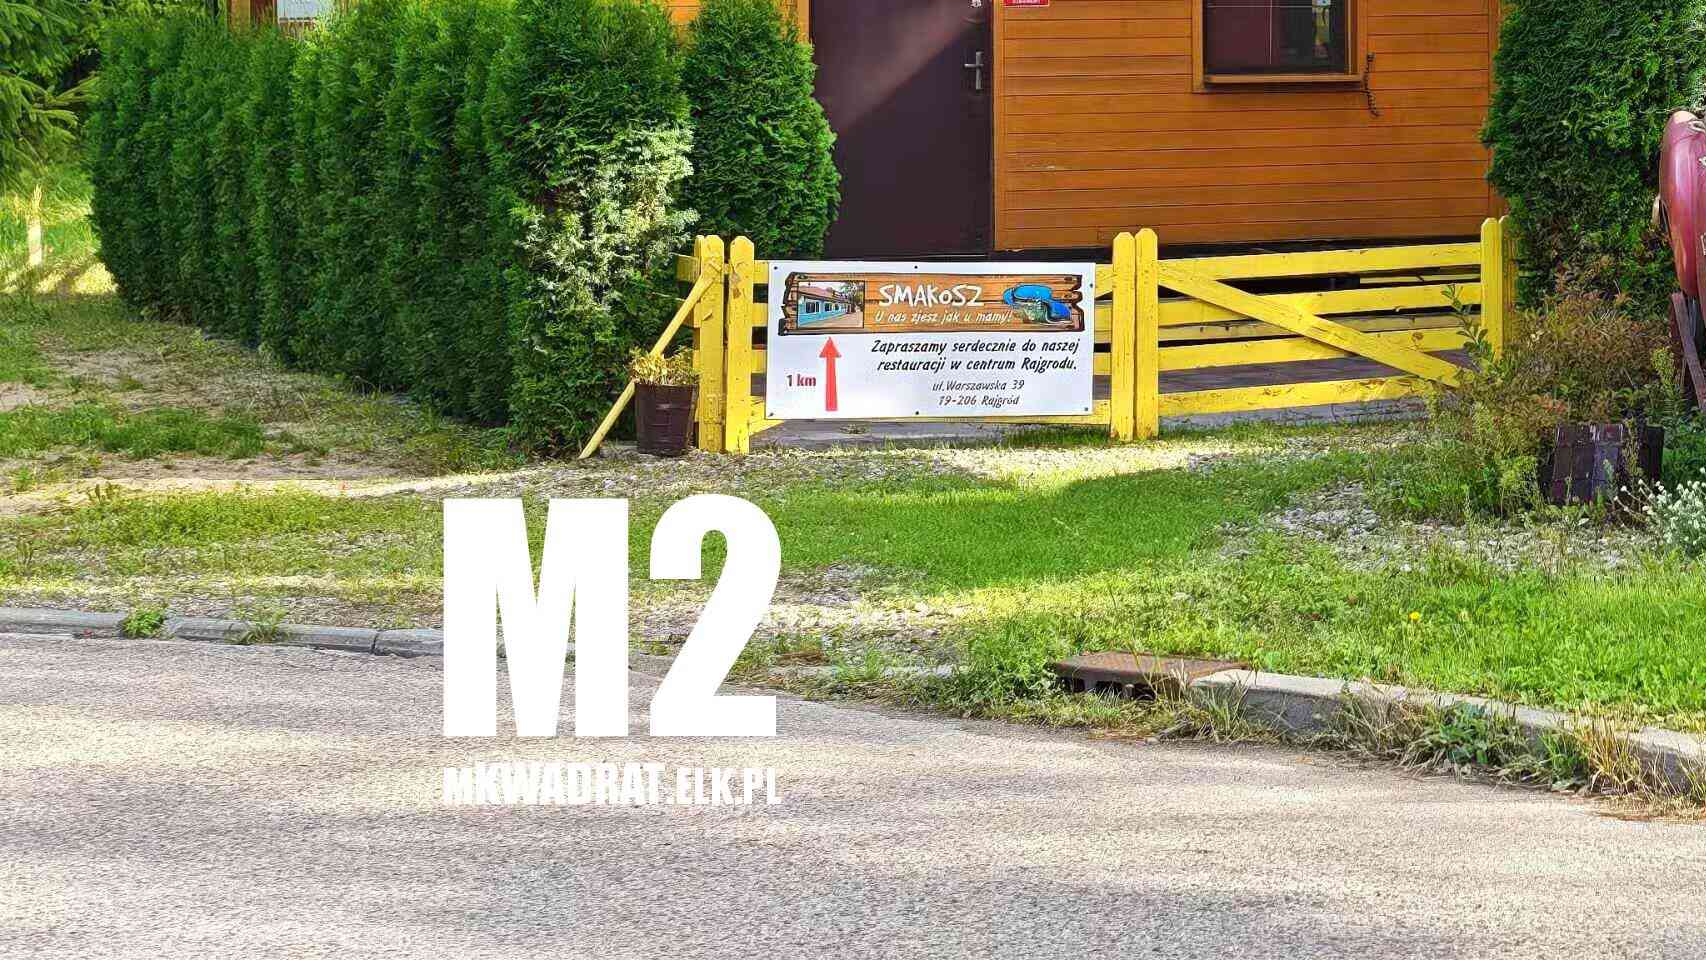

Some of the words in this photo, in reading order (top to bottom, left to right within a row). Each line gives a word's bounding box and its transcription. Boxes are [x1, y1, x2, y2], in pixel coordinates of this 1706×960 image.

[875, 311, 885, 322] U
[888, 313, 906, 321] nas
[911, 311, 939, 324] zjesz
[940, 310, 960, 324] jak
[963, 312, 972, 321] u
[976, 310, 1013, 324] mamy!
[871, 339, 948, 355] Zapraszamy
[952, 339, 1017, 353] serdecznie
[1021, 338, 1037, 352] do
[1041, 338, 1081, 355] naszej
[877, 356, 947, 374] restauracji
[950, 360, 960, 371] w
[966, 358, 1016, 371] centrum
[1021, 356, 1077, 374] Rajgrodu.
[786, 374, 793, 387] 1
[796, 373, 817, 387] km
[1011, 379, 1025, 390] 39
[938, 395, 977, 406] 19-206
[981, 394, 1020, 408] Rajgród
